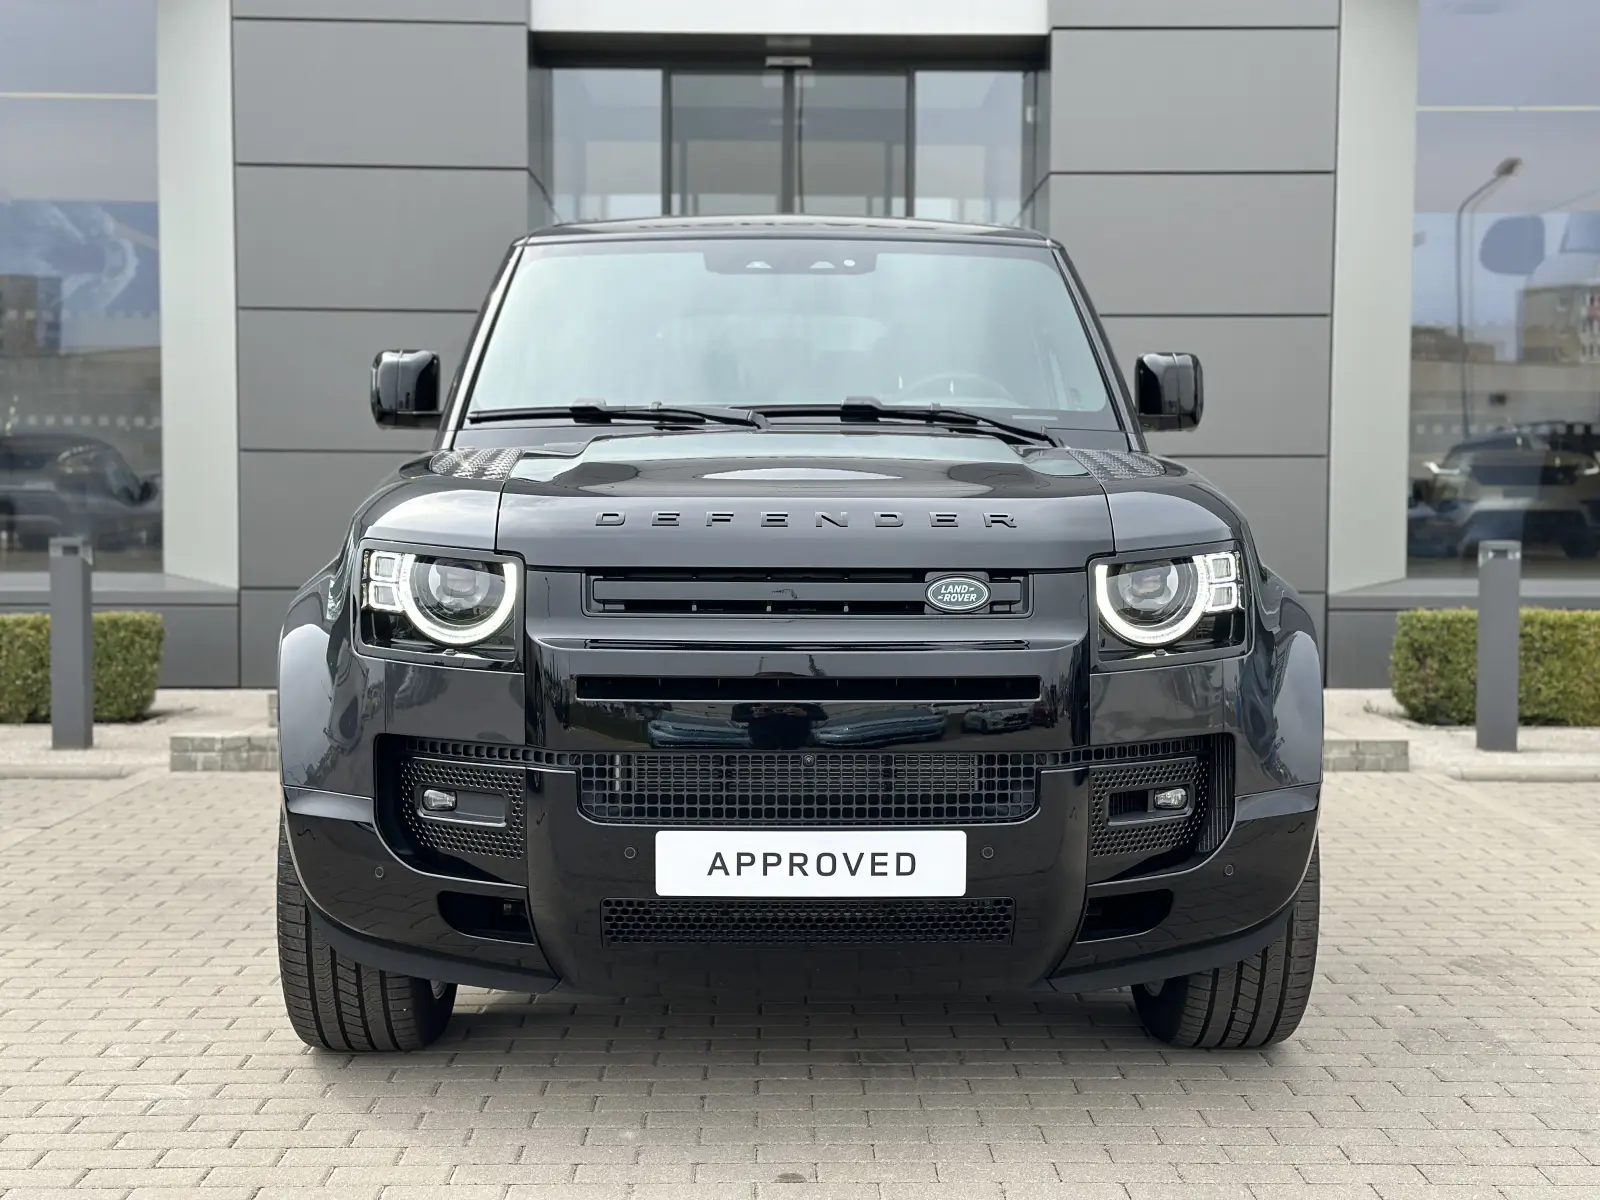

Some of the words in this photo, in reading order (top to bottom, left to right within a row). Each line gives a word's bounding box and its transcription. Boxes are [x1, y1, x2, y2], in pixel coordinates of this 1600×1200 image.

[595, 511, 1017, 528] DEFENDER
[940, 585, 969, 593] LAND
[943, 593, 977, 602] ROVER
[706, 852, 917, 876] APPROVED
